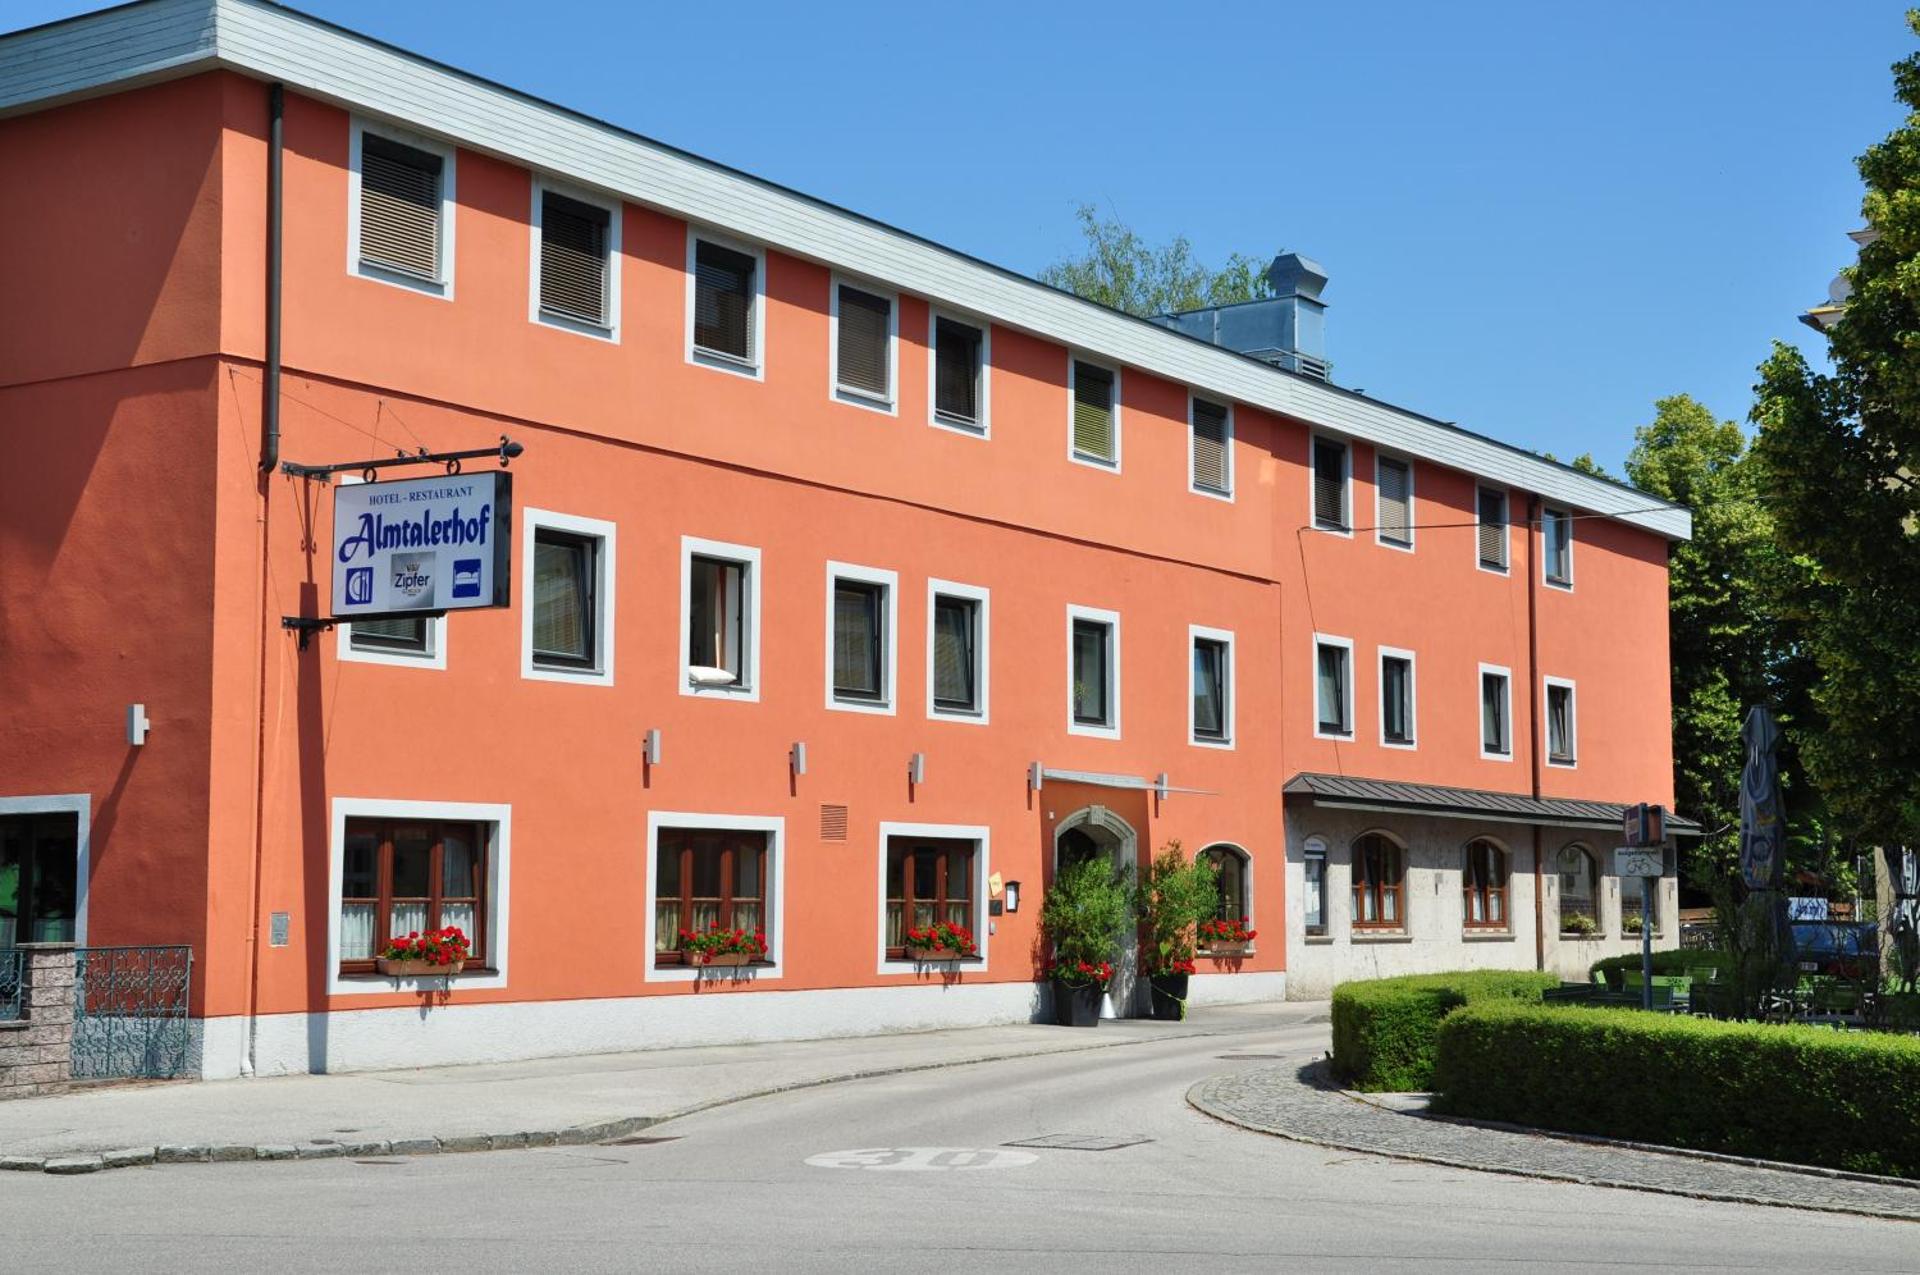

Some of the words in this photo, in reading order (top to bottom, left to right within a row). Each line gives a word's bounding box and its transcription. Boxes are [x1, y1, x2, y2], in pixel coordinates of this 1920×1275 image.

[369, 493, 401, 506] HOTEL
[409, 486, 474, 502] RESTAURANT
[339, 504, 490, 563] Almtalerhof
[395, 572, 430, 590] Zipfer
